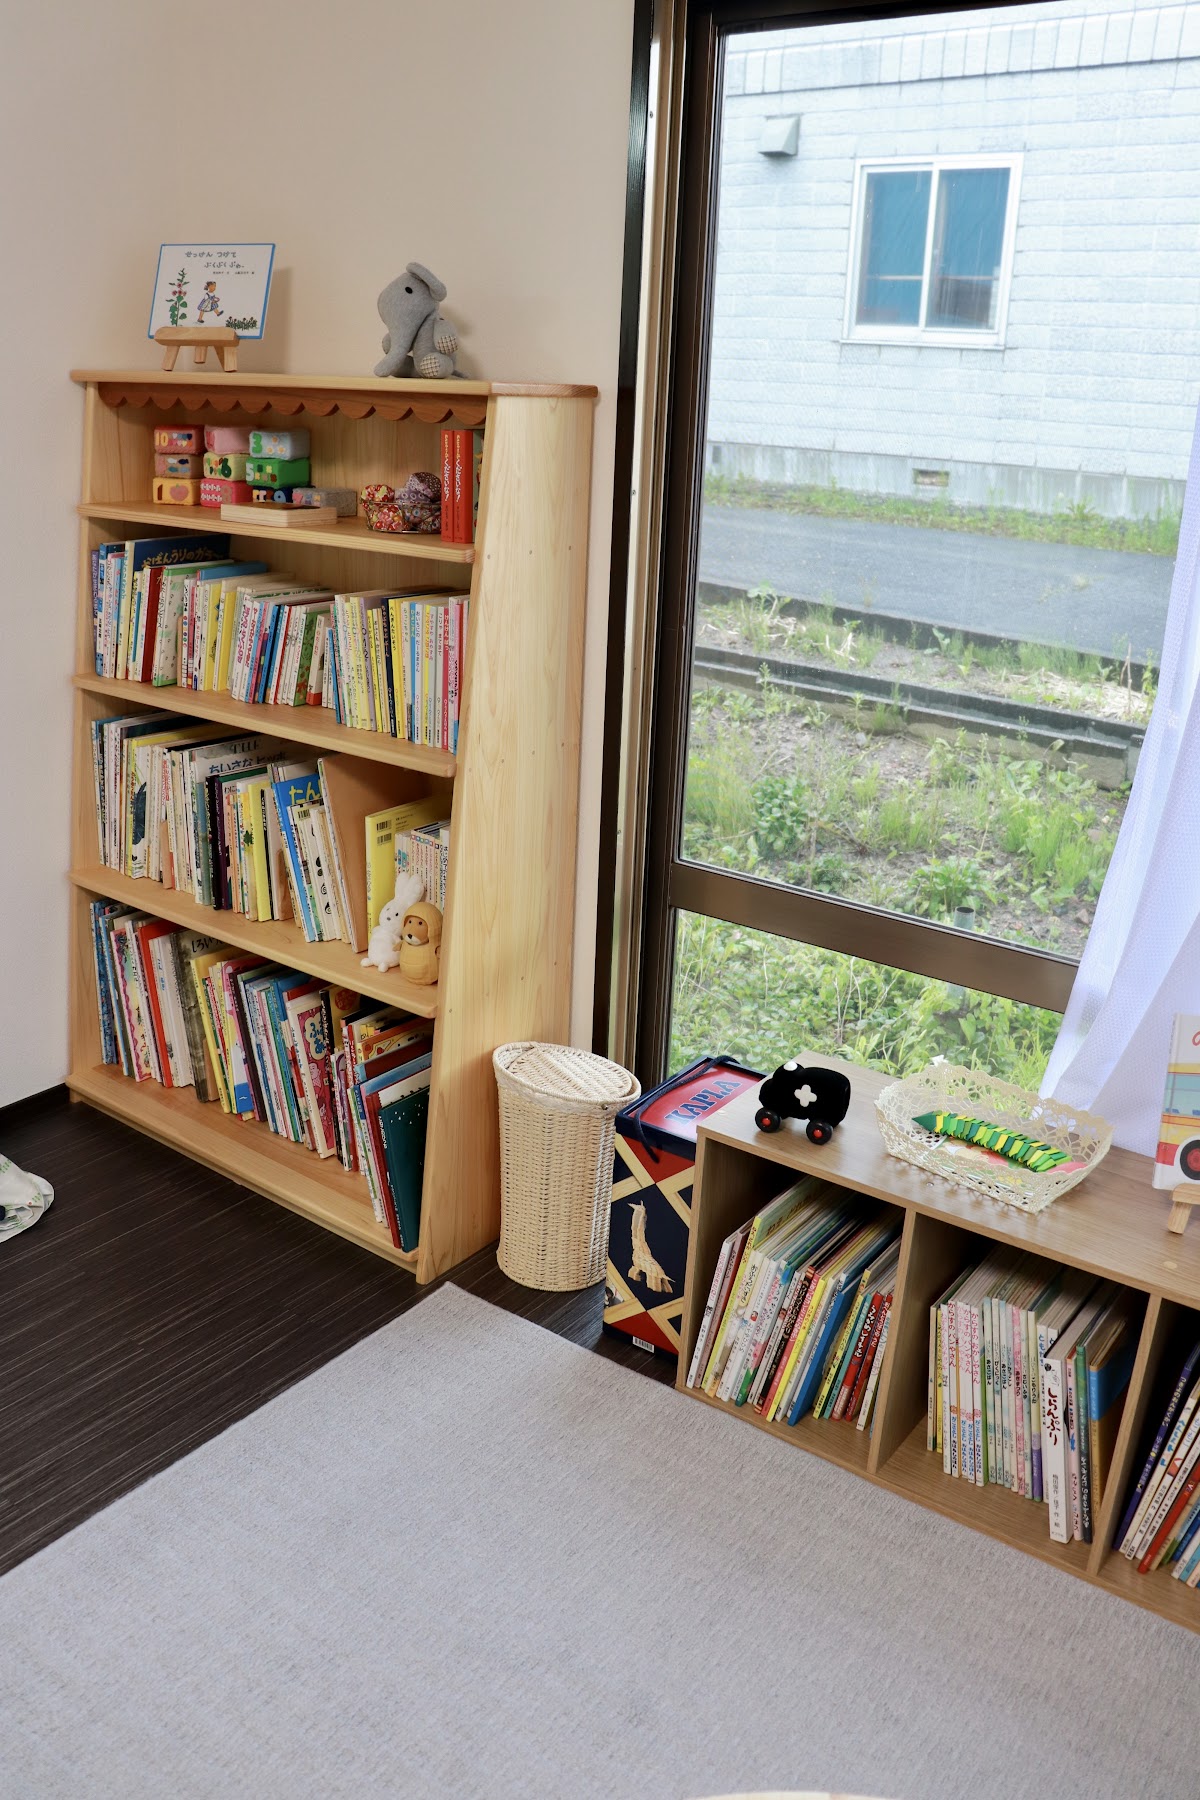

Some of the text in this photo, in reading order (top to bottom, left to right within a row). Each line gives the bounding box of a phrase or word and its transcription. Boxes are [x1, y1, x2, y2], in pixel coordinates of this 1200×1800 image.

[155, 432, 168, 446] 10
[252, 433, 263, 454] 3
[220, 457, 232, 478] 6
[245, 462, 255, 482] 5
[209, 758, 253, 774] ちいさな
[289, 779, 322, 805] たん
[664, 1077, 743, 1126] KAPLA
[948, 1302, 956, 1368] からすの パンやさん
[963, 1309, 972, 1375] からすの パンやさん
[971, 1313, 980, 1384] からすの おかしやさん
[1046, 1387, 1061, 1446] しらんぷり
